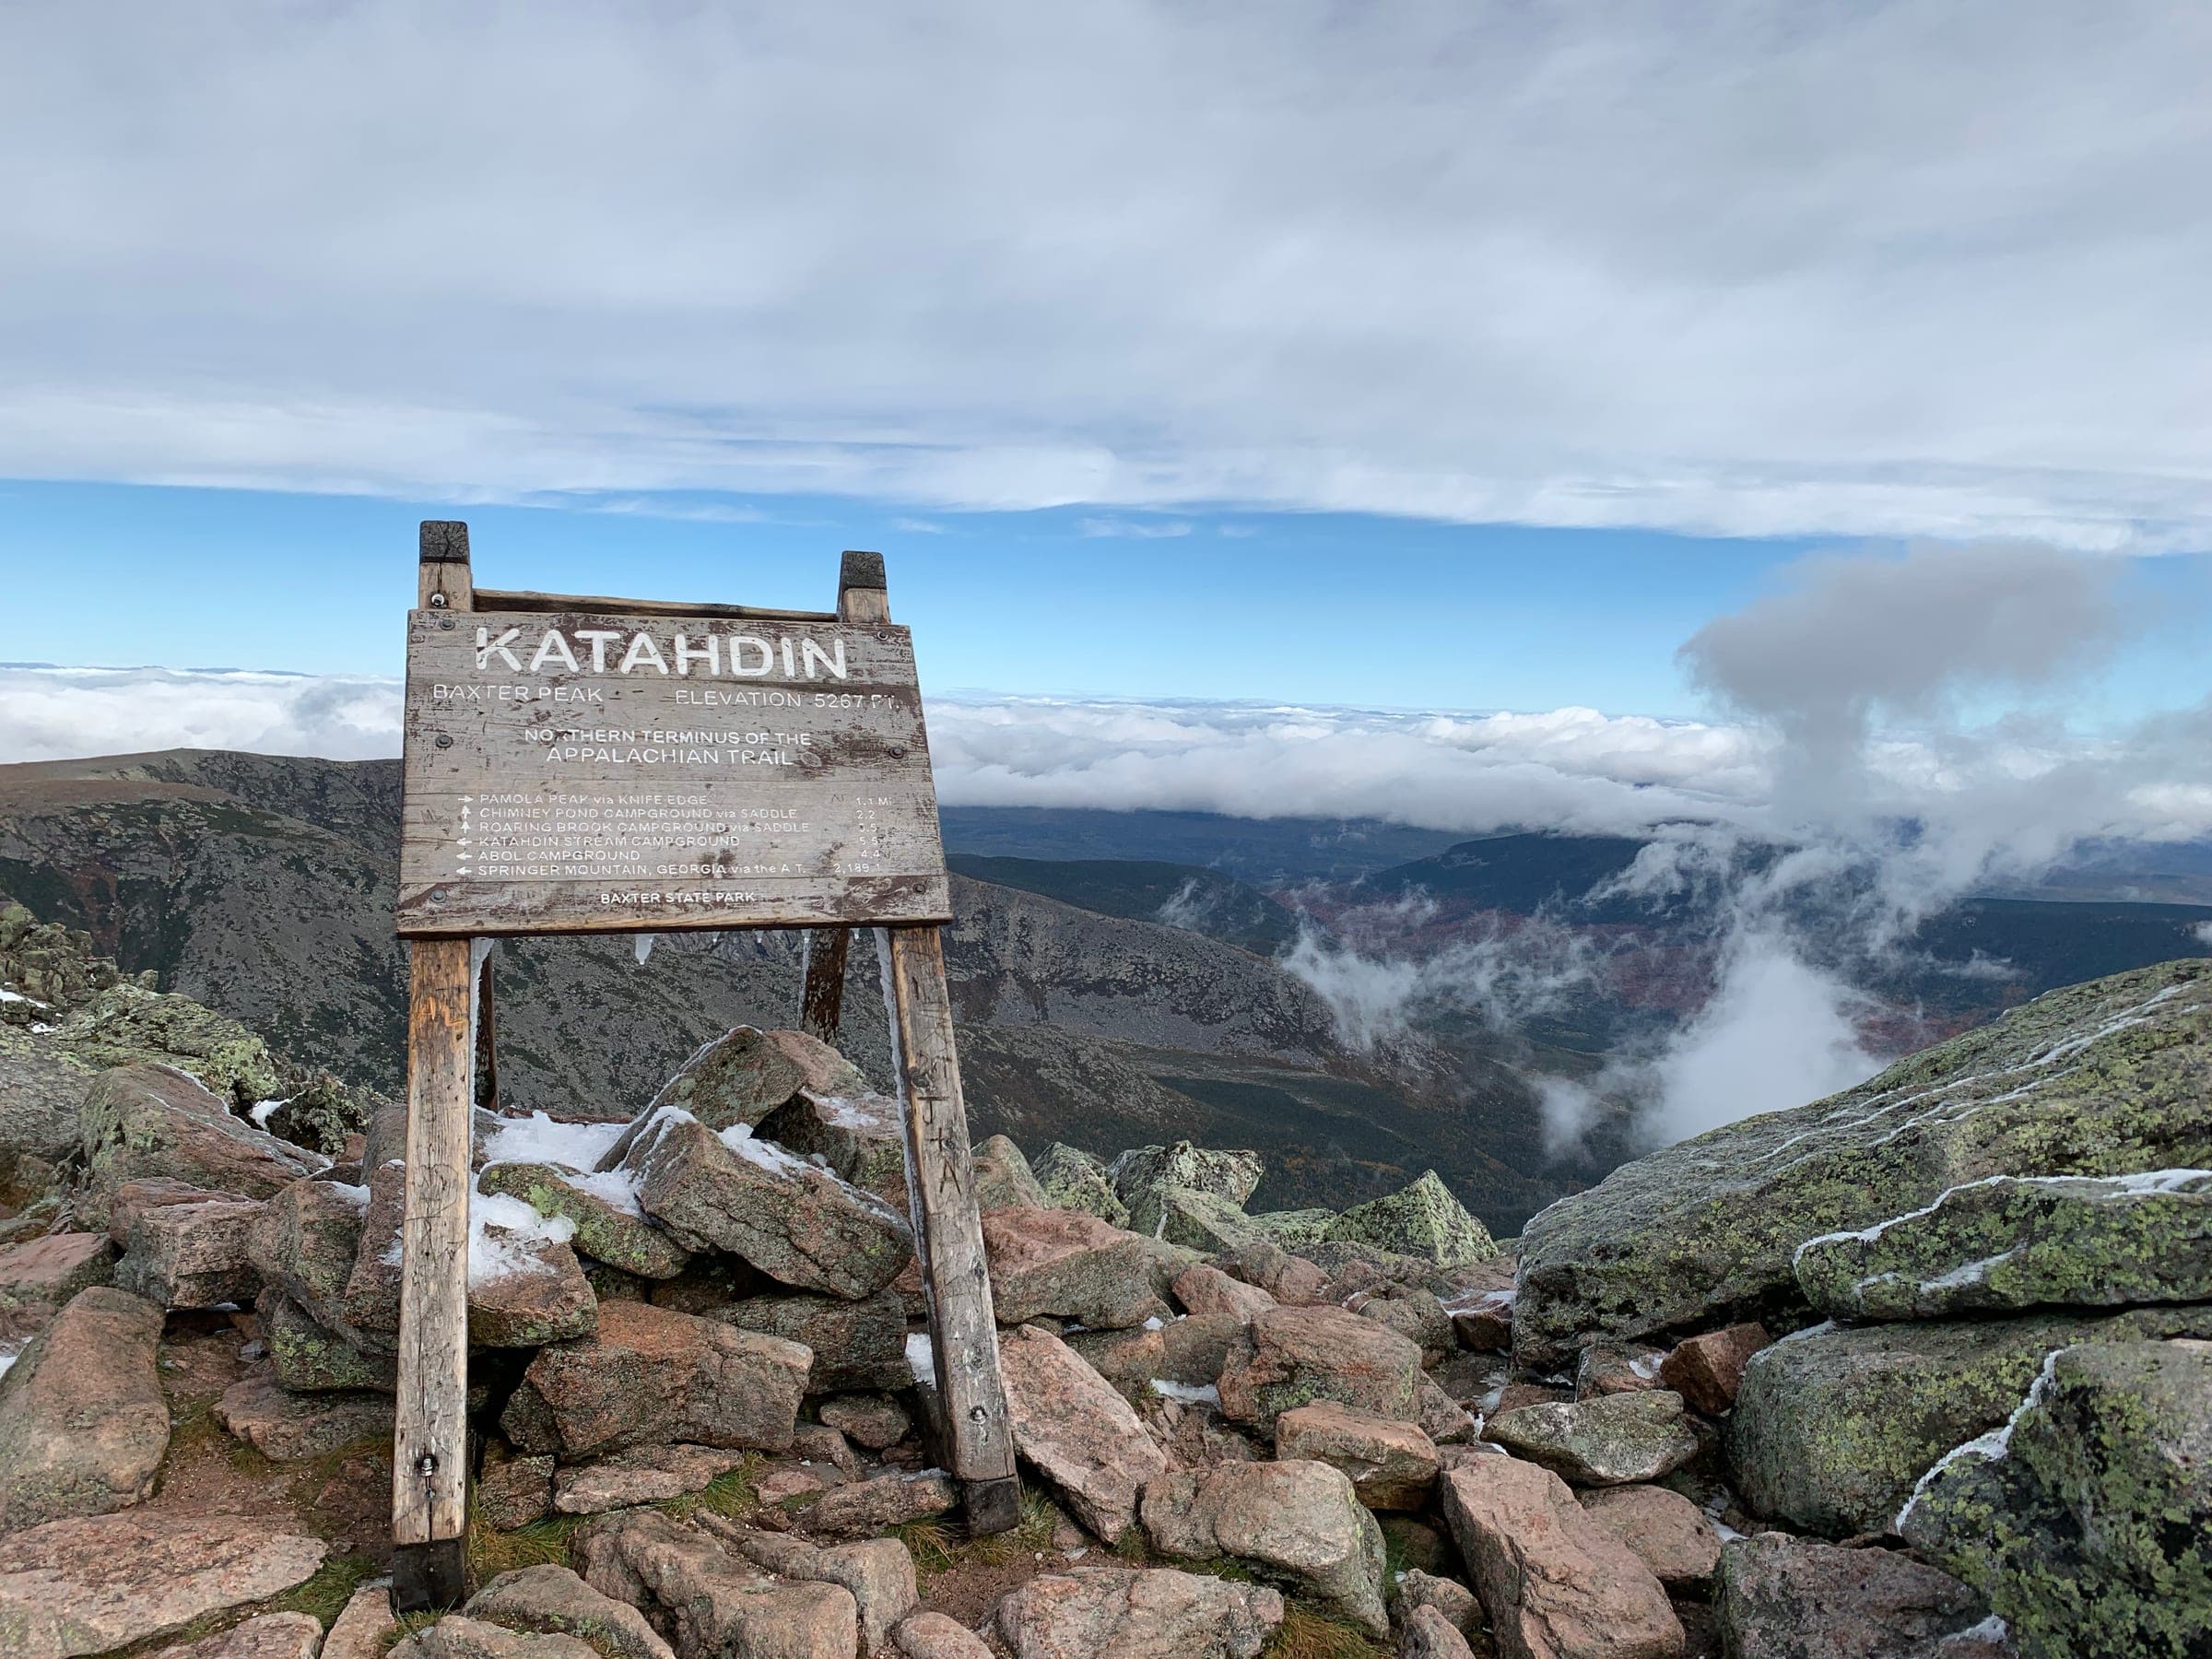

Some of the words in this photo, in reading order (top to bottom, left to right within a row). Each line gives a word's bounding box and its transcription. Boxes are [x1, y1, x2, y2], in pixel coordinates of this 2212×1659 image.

[476, 628, 847, 679] KATAHDIN
[433, 684, 530, 700] BAXTER
[538, 686, 604, 701] PEAK
[676, 689, 801, 707] ELEVATION
[814, 693, 863, 709] 5267
[524, 729, 635, 743] NORTHERN
[641, 730, 740, 745] TERMINUS
[745, 732, 769, 745] OF
[774, 733, 812, 746] THE
[546, 747, 719, 764] APPALACHIAN
[727, 748, 794, 766] TRAIL
[479, 794, 544, 804] PAMOLA
[548, 794, 590, 804] PEAK
[593, 795, 614, 805] via
[618, 794, 663, 805] KNIFE
[667, 795, 708, 805] EDGE
[479, 808, 550, 818] CHIMNEY
[555, 808, 598, 818] POND
[604, 809, 712, 818] CAMPGROUND
[715, 809, 739, 818] via
[740, 809, 797, 818] SADDLE
[856, 810, 876, 819] 2.2
[479, 822, 551, 832] ROARING
[556, 822, 612, 832] BROOK
[617, 823, 725, 832] CAMPGROUND
[729, 824, 749, 832] via
[750, 823, 810, 832] SADDLE
[479, 837, 559, 846] KATAHDIN
[564, 837, 626, 846] STREAM
[631, 836, 740, 846] CAMPGROUND
[859, 836, 878, 845] 55
[477, 851, 523, 861] ABOL
[527, 851, 641, 861] CAMPGROUND
[861, 850, 880, 859] 4.4
[477, 865, 559, 876] SPRINGER
[564, 865, 652, 876] MOUNTAIN,
[656, 864, 726, 875] GEORGIA
[730, 865, 751, 874] via
[754, 865, 776, 873] the
[600, 893, 661, 904] BAXTER
[665, 892, 712, 903] STATE
[715, 891, 757, 902] PARK
